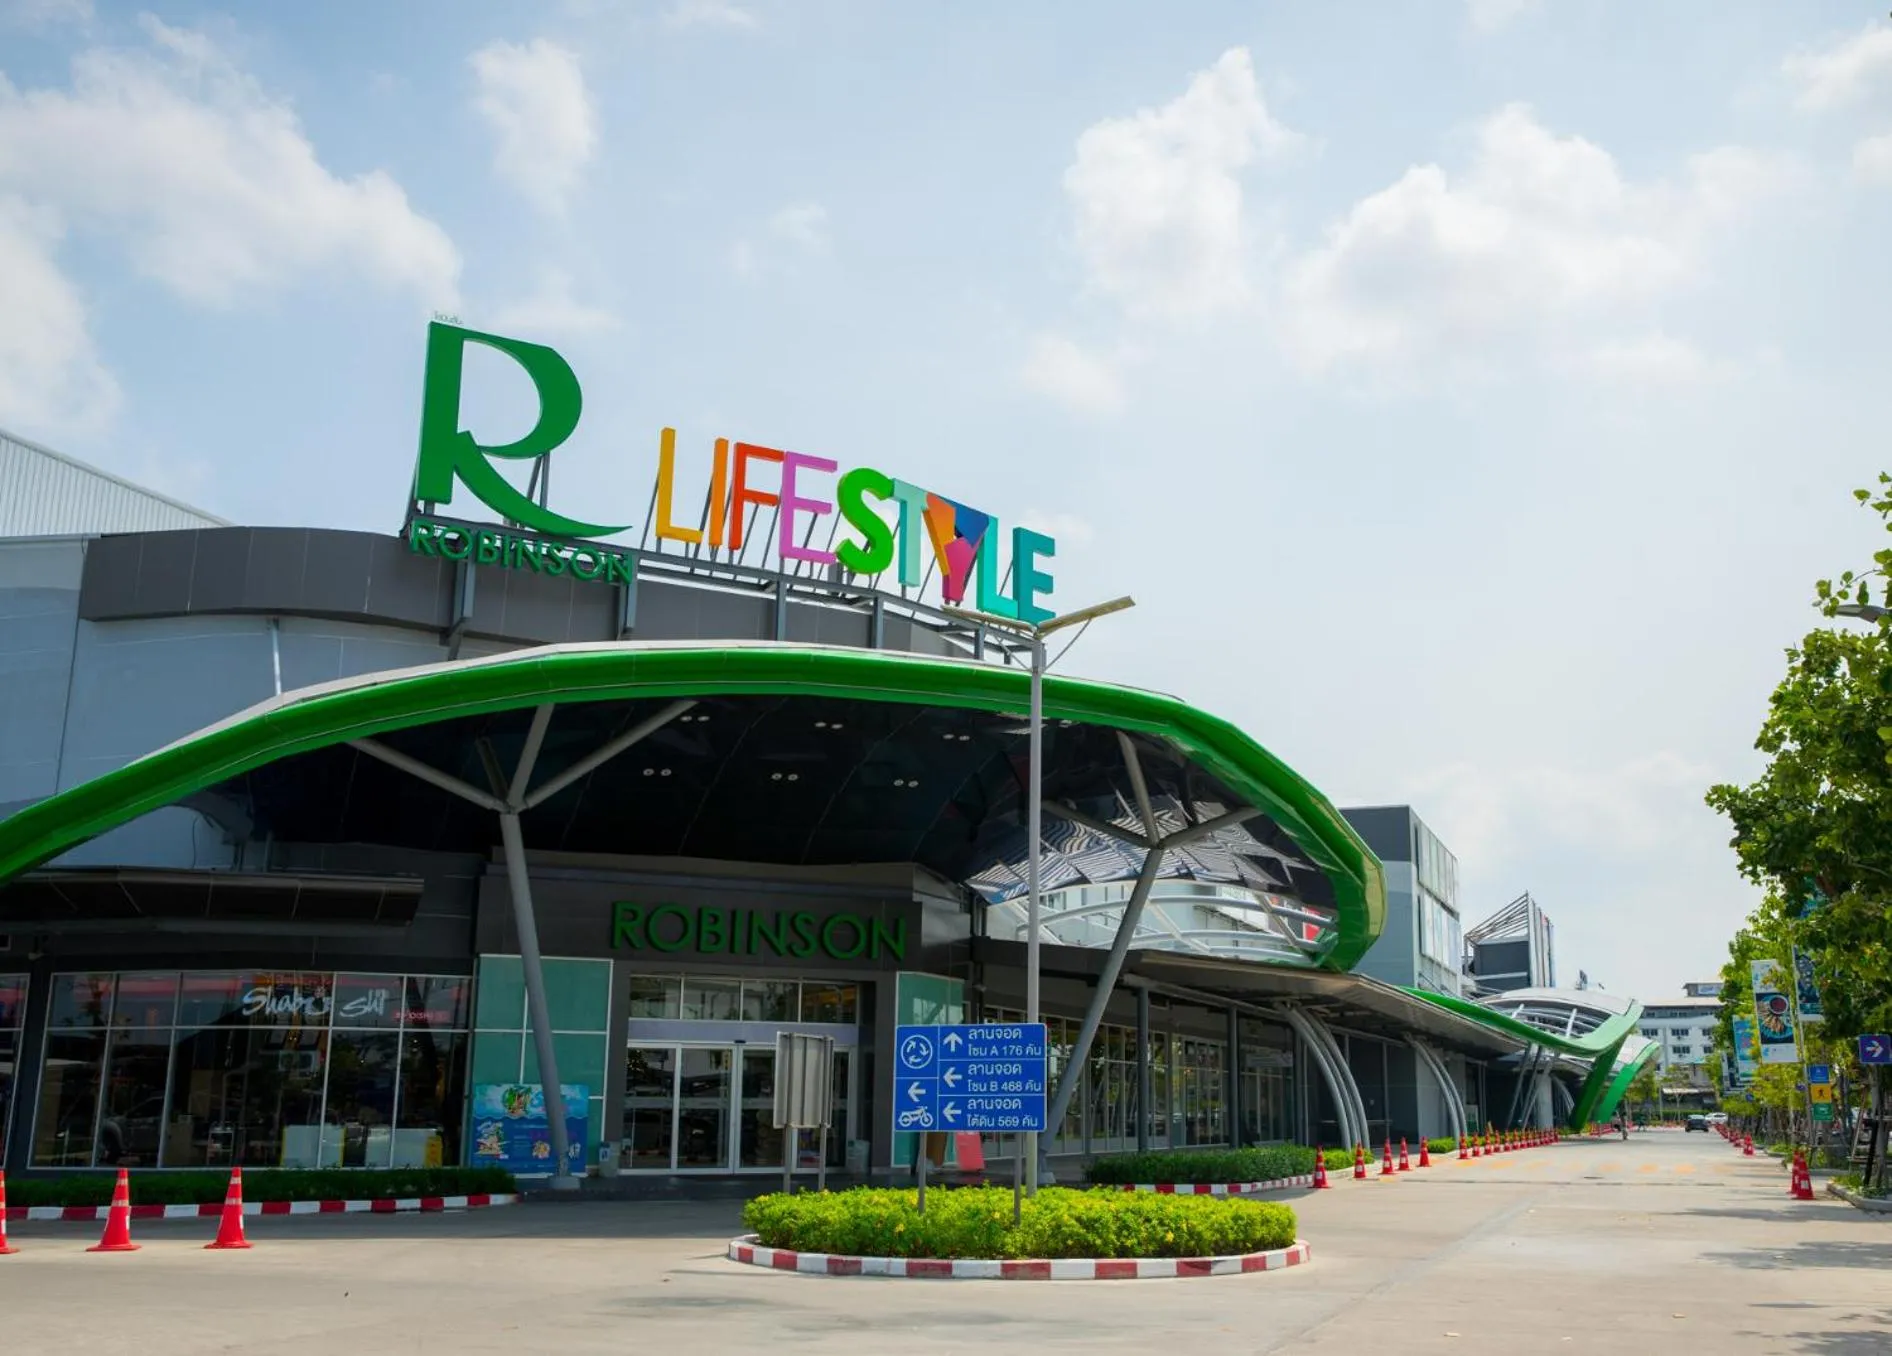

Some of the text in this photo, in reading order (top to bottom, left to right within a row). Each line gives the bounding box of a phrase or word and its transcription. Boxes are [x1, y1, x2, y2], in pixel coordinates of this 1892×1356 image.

[414, 321, 630, 538] R
[656, 427, 1056, 623] LIFESTYLE
[409, 518, 632, 585] ROBINSON
[611, 901, 906, 961] ROBINSON
[968, 1028, 1022, 1040] ลานจอด
[989, 1045, 999, 1056] A
[1003, 1045, 1023, 1056] 176
[968, 1063, 1022, 1075] ลานจอด
[989, 1081, 999, 1092] B
[1001, 1081, 1023, 1092] 468
[967, 1098, 1021, 1110] ลานจอด
[997, 1116, 1019, 1127] 569
